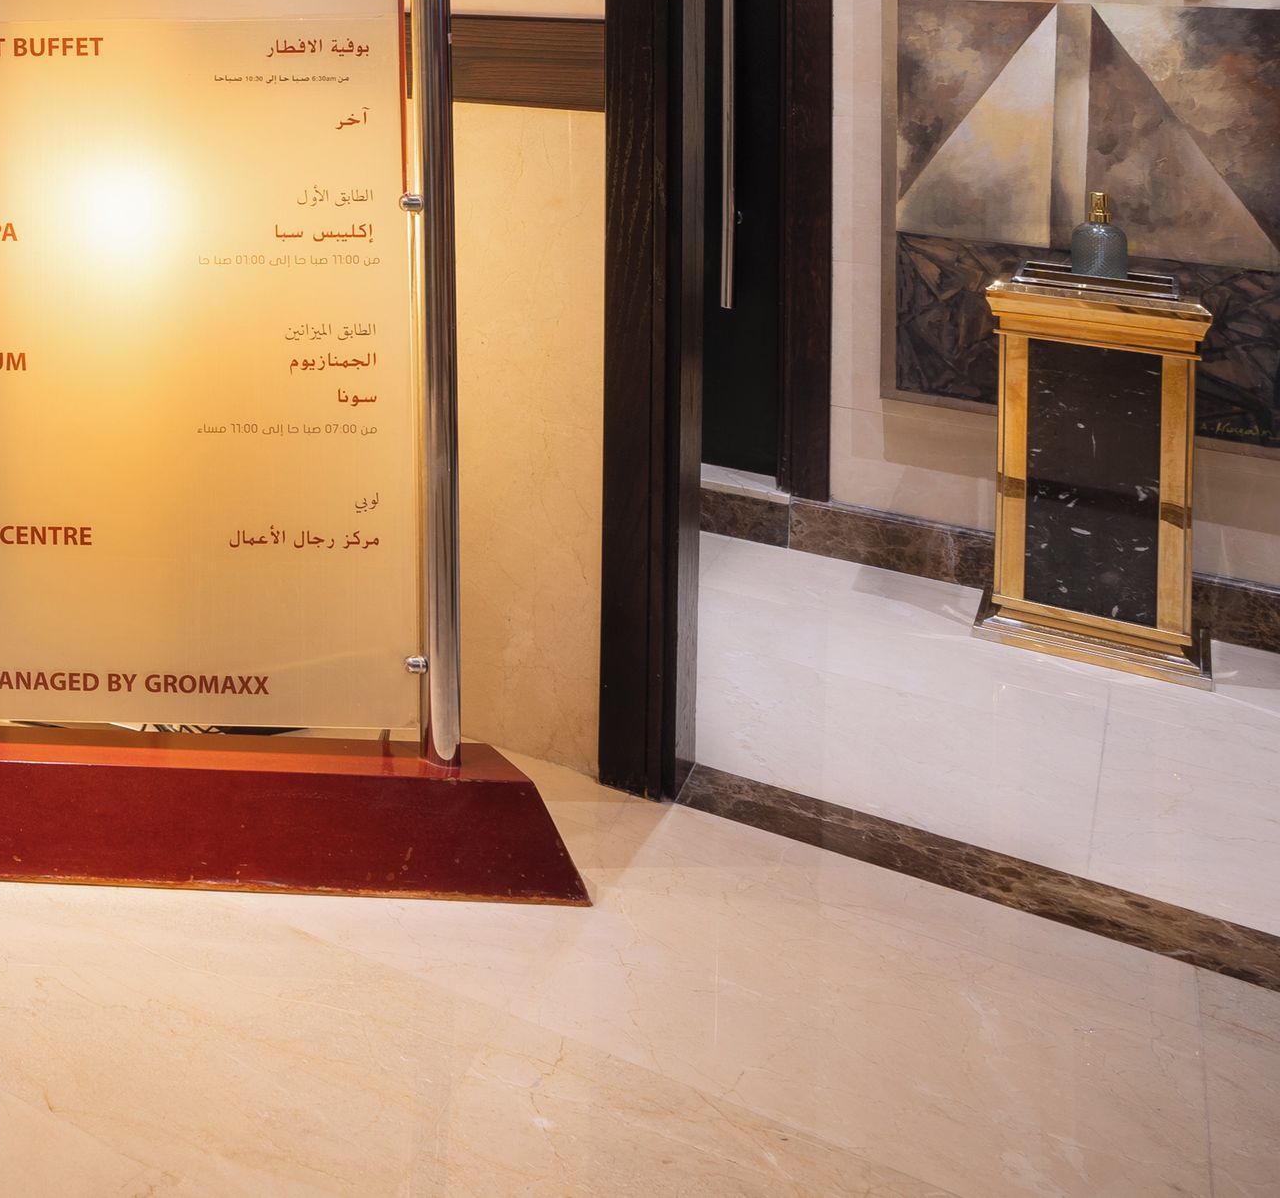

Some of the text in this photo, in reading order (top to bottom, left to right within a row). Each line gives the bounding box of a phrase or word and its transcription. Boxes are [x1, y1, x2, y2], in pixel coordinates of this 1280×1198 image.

[13, 37, 104, 58] BUFFET
[244, 75, 264, 83] 10:30
[335, 106, 370, 131] آخر
[296, 184, 374, 208] الطابق الأول
[274, 223, 374, 244] إكليبس سبا
[268, 254, 291, 268] إلى
[284, 323, 377, 342] الطابق الميزانين
[289, 352, 377, 375] الجمنازيوم
[337, 388, 378, 408] سونا
[261, 423, 284, 437] إلى
[354, 492, 380, 514] لوبي
[0, 525, 93, 546] CENTRE
[229, 524, 380, 550] مركز رجال الأعمال
[107, 673, 138, 693] BY
[144, 673, 270, 696] GROMAXX
